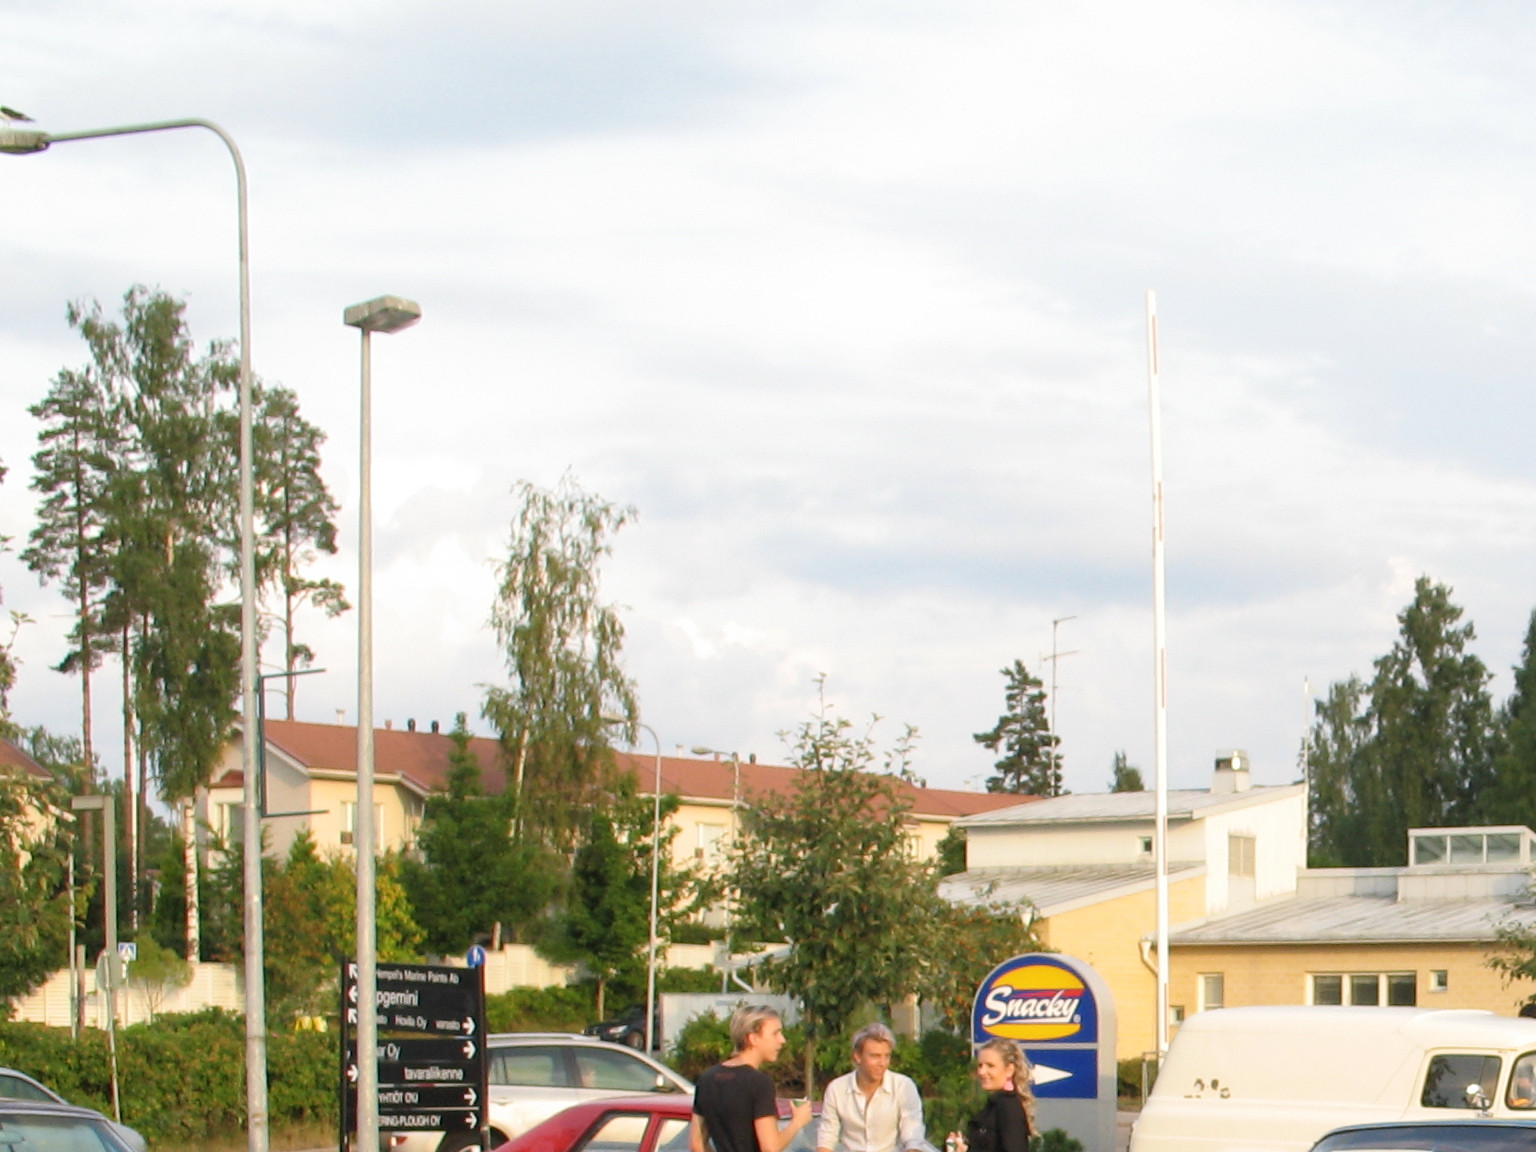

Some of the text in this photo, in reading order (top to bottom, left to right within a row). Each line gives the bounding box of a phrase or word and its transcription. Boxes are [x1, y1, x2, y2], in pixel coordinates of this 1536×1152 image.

[376, 989, 419, 1009] pgemini
[982, 985, 1080, 1026] Snacky
[416, 1015, 428, 1030] Oy
[387, 1042, 400, 1061] Oy
[404, 1065, 464, 1081] tavaraliikenne
